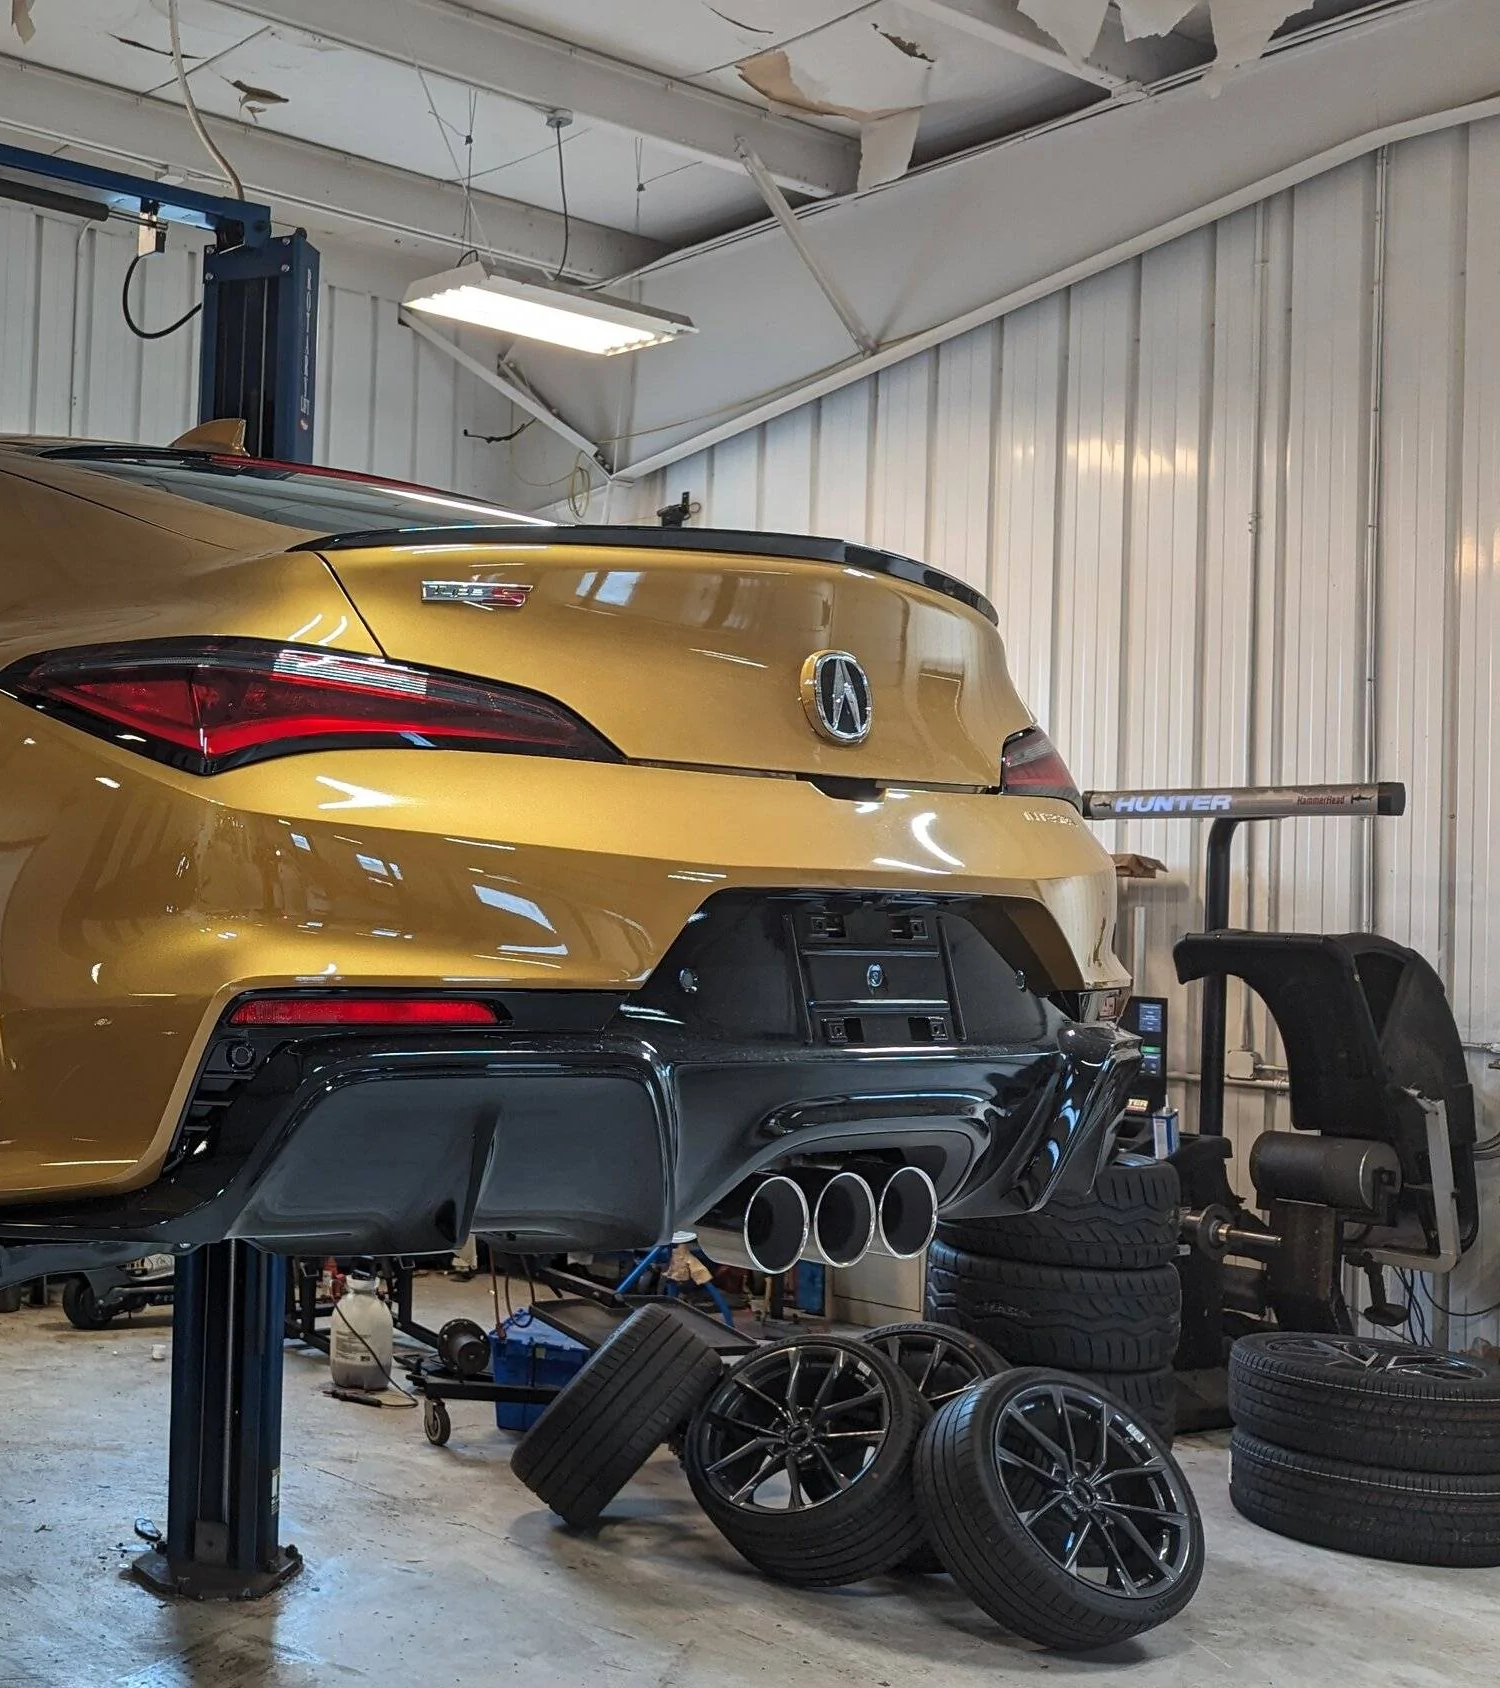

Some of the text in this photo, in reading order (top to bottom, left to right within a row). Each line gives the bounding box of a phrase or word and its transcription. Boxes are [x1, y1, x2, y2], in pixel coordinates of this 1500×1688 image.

[303, 268, 312, 397] ROTARY
[1115, 795, 1232, 812] HUNTER
[1297, 795, 1346, 805] HammerHead
[1128, 1098, 1149, 1107] TER
